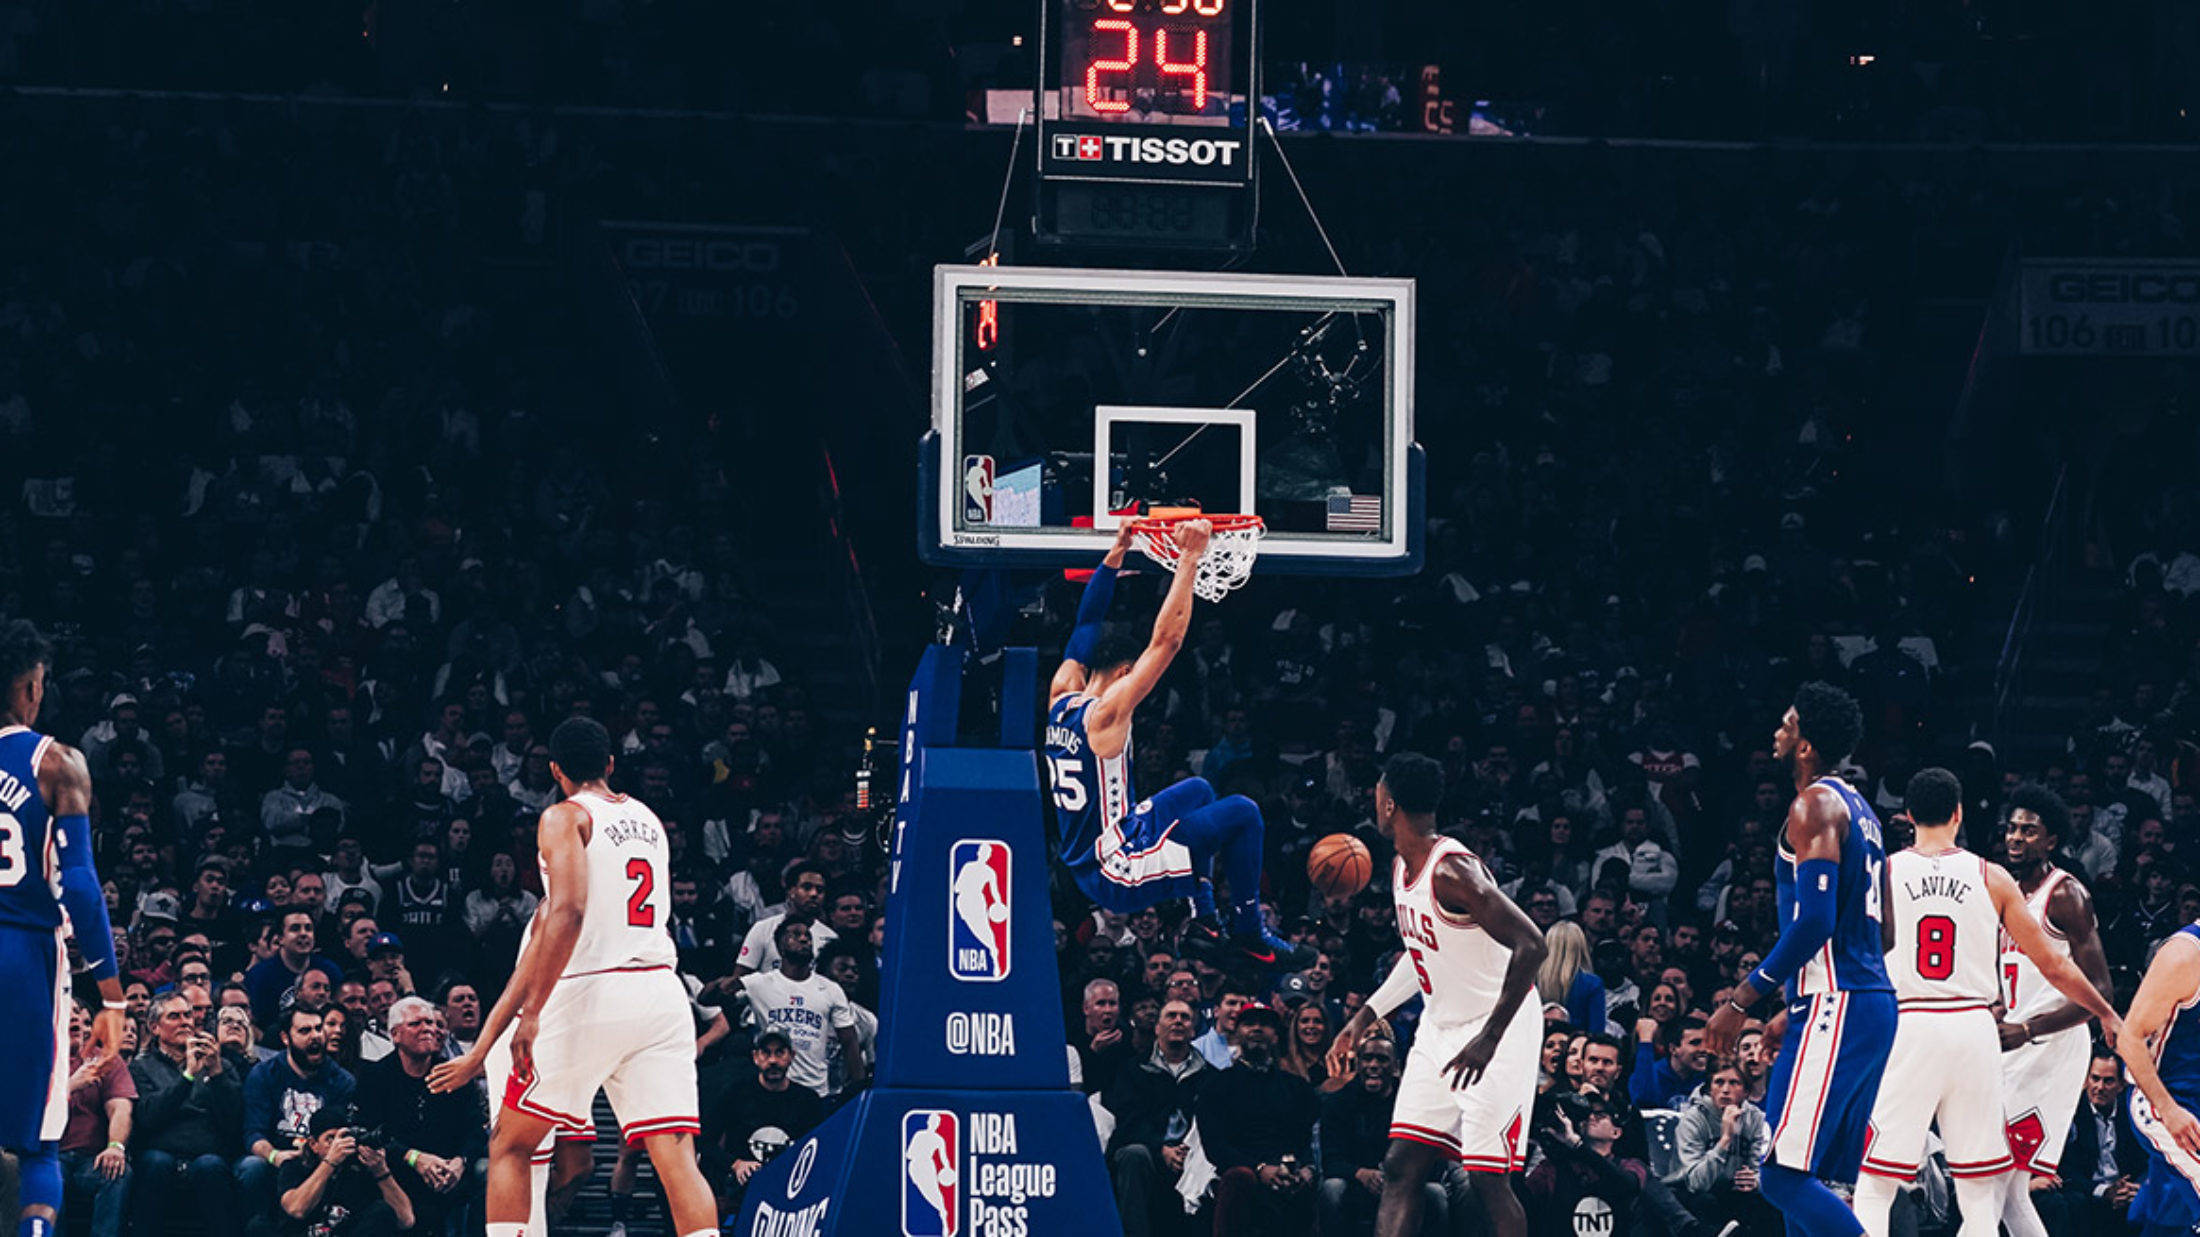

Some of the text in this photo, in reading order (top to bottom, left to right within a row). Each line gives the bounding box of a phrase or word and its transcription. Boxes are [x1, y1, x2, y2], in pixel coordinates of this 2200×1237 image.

[1087, 19, 1207, 113] 24
[1104, 136, 1241, 166] TISSOT
[625, 239, 781, 273] GEICO
[733, 283, 800, 319] 106
[2029, 314, 2097, 348] 106
[604, 818, 659, 849] PARKER
[626, 857, 654, 928] 2
[1904, 875, 1972, 904] LAVINE
[958, 948, 988, 972] NBA
[1916, 913, 1956, 981] 8
[1408, 945, 1433, 996] 5
[768, 1008, 822, 1030] SIXERS
[945, 1011, 1016, 1056] @NBA
[969, 1112, 1018, 1155] NBA
[969, 1155, 1056, 1205] League
[968, 1197, 1029, 1237] Pass
[1573, 1211, 1613, 1232] TNT
